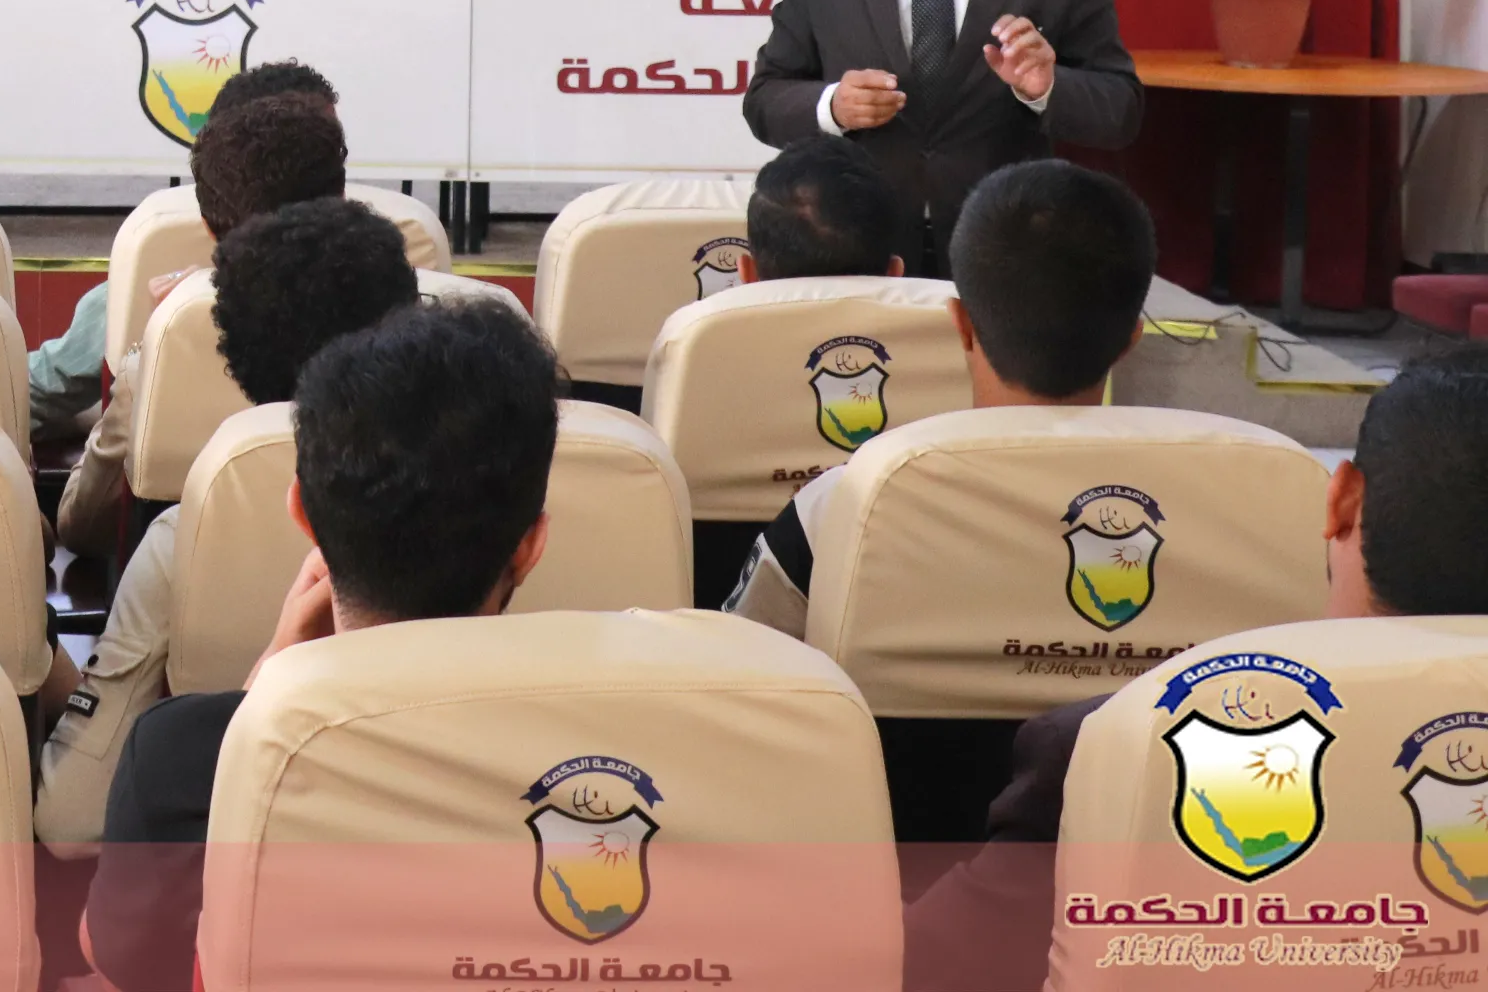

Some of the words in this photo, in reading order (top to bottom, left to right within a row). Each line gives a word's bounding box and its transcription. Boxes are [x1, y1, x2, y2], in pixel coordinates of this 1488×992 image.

[557, 58, 752, 95] لحكمة
[773, 465, 825, 483] كمة
[1003, 639, 1110, 660] الحكمة
[1115, 642, 1196, 661] معة
[1017, 659, 1102, 679] Al-Hikma
[1415, 715, 1465, 744] الحكمة
[543, 758, 589, 787] الحكمة
[592, 758, 641, 782] جامعة
[452, 956, 589, 982] الحكمة
[599, 957, 732, 987] جامعة
[1369, 964, 1479, 992] Al-Hikma
